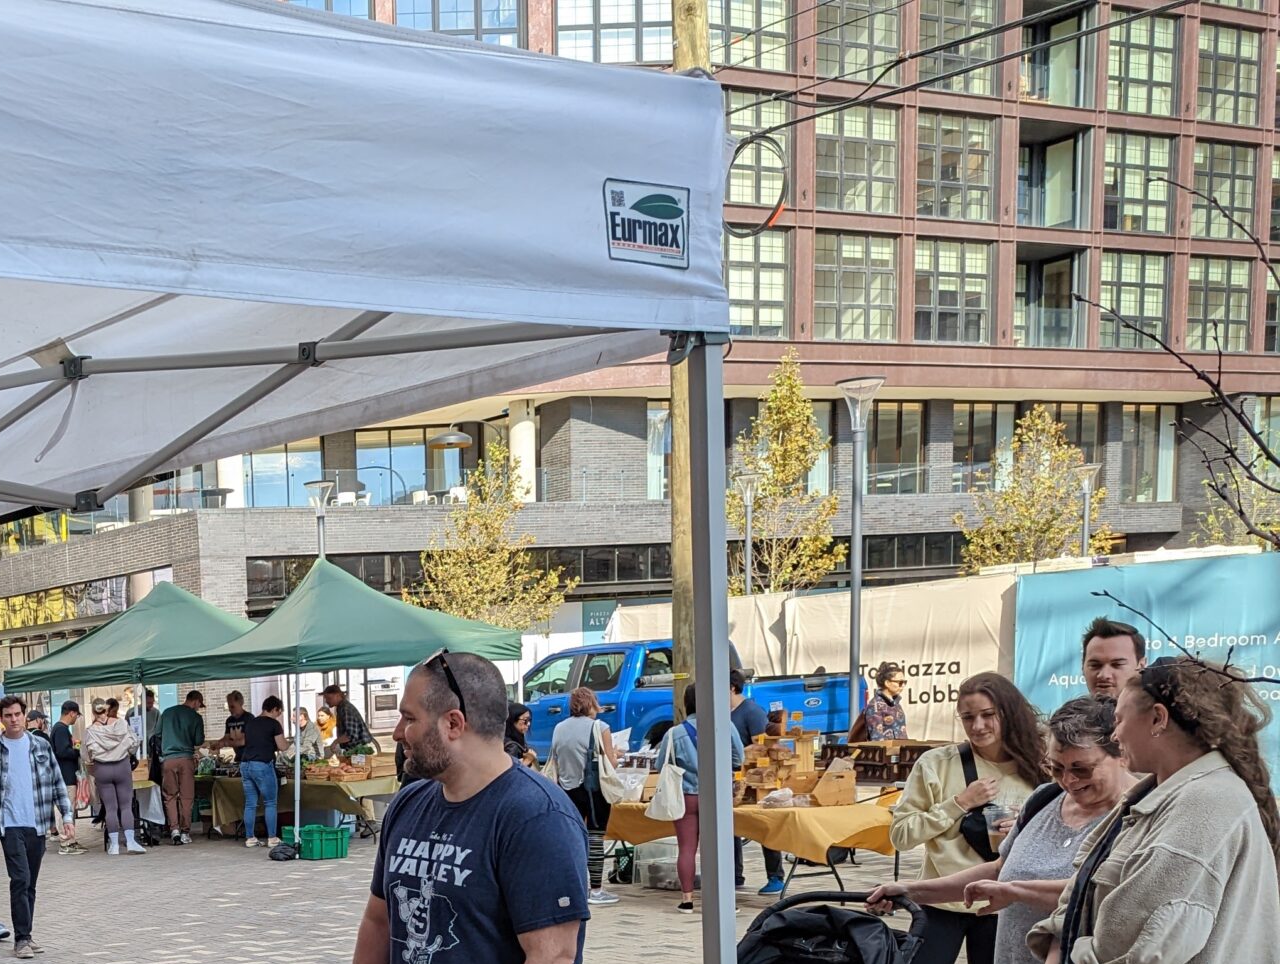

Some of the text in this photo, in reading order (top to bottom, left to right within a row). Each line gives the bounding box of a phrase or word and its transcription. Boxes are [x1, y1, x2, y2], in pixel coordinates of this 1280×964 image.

[609, 211, 681, 249] Eurmax
[1184, 631, 1267, 649] Bedroom
[908, 684, 960, 705] Lobb
[397, 837, 473, 866] HAPPY
